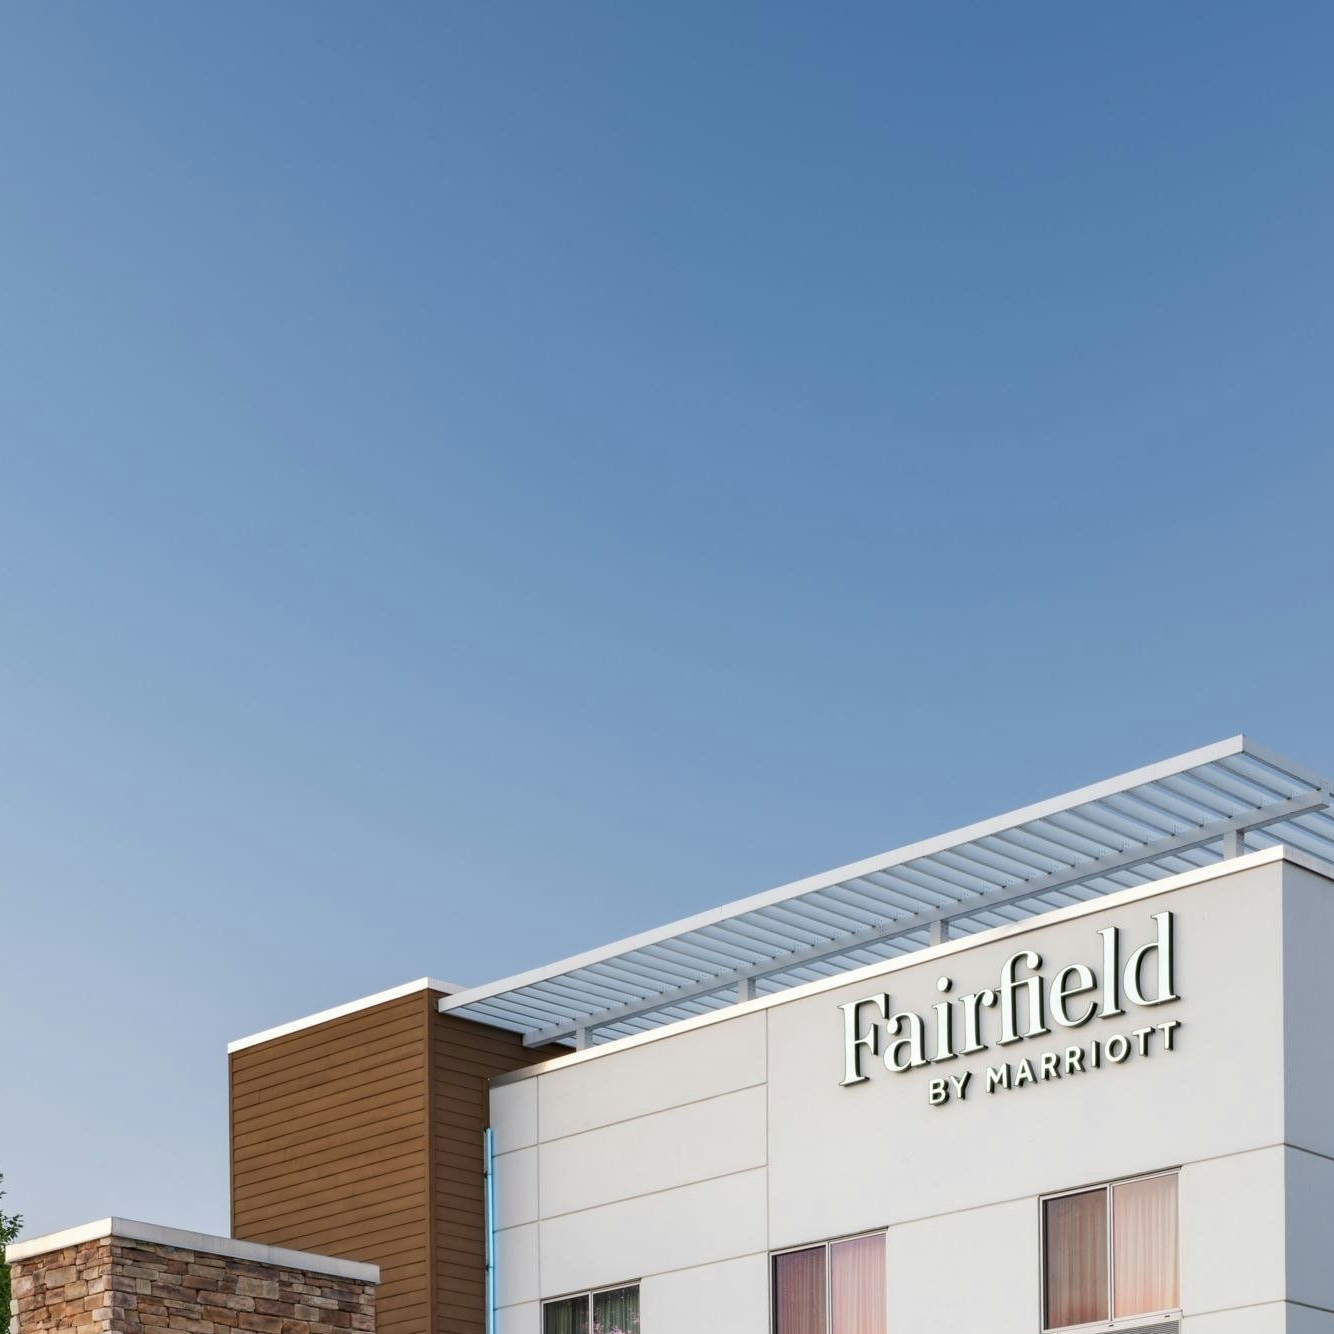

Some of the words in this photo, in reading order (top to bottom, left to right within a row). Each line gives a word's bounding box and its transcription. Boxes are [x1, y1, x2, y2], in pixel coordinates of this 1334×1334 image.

[838, 911, 1180, 1086] Fairfield
[929, 1072, 972, 1106] BY
[986, 1021, 1180, 1093] MARRIOTT
